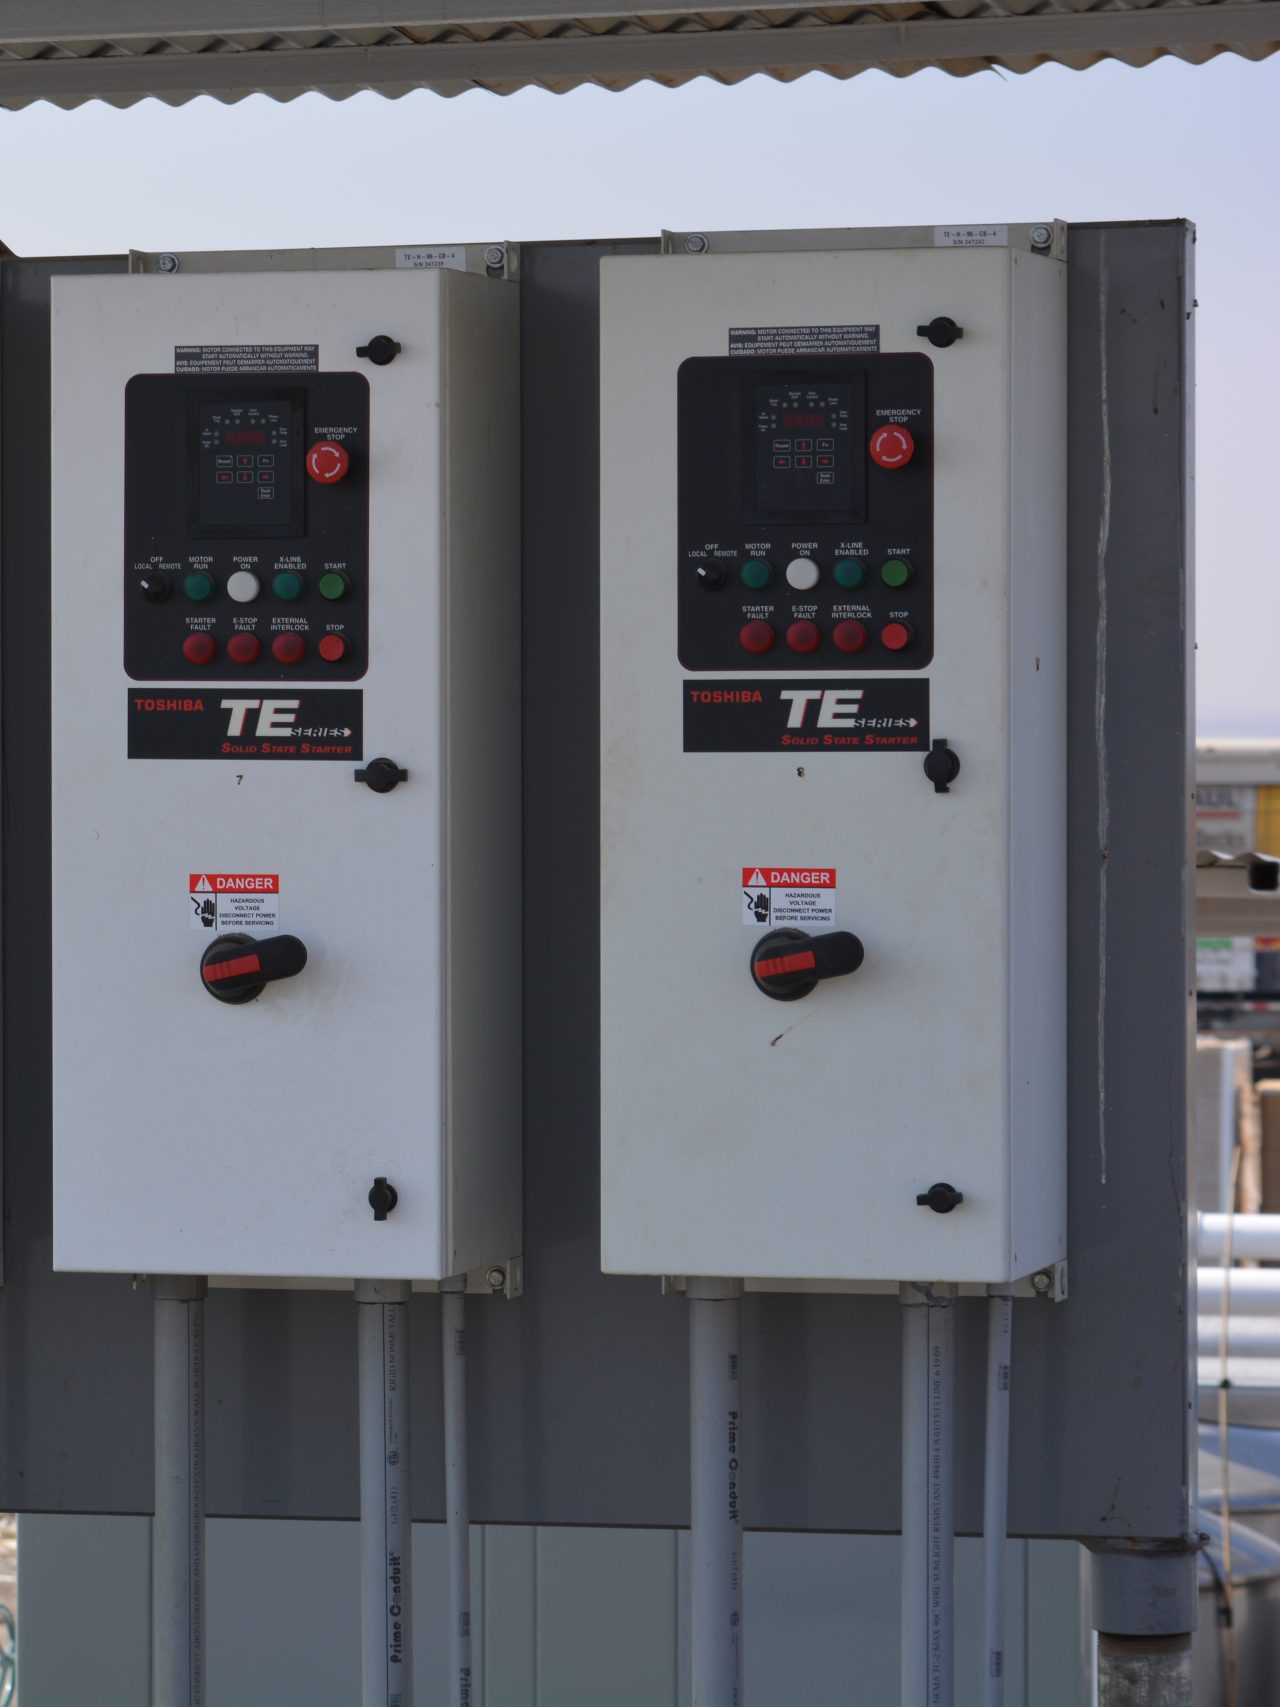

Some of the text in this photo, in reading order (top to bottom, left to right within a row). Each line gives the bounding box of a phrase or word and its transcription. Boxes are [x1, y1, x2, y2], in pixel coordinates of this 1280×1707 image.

[691, 691, 762, 702] TOSHIBA
[135, 700, 204, 710] TOSHIBA
[780, 690, 911, 728] TE SERIES
[220, 700, 345, 736] TE SERIES
[236, 775, 243, 785] 7
[217, 878, 273, 888] DANGER
[771, 873, 830, 883] DANGER
[729, 1412, 739, 1520] Prime Conduit
[389, 1556, 401, 1663] Prime Conduit
